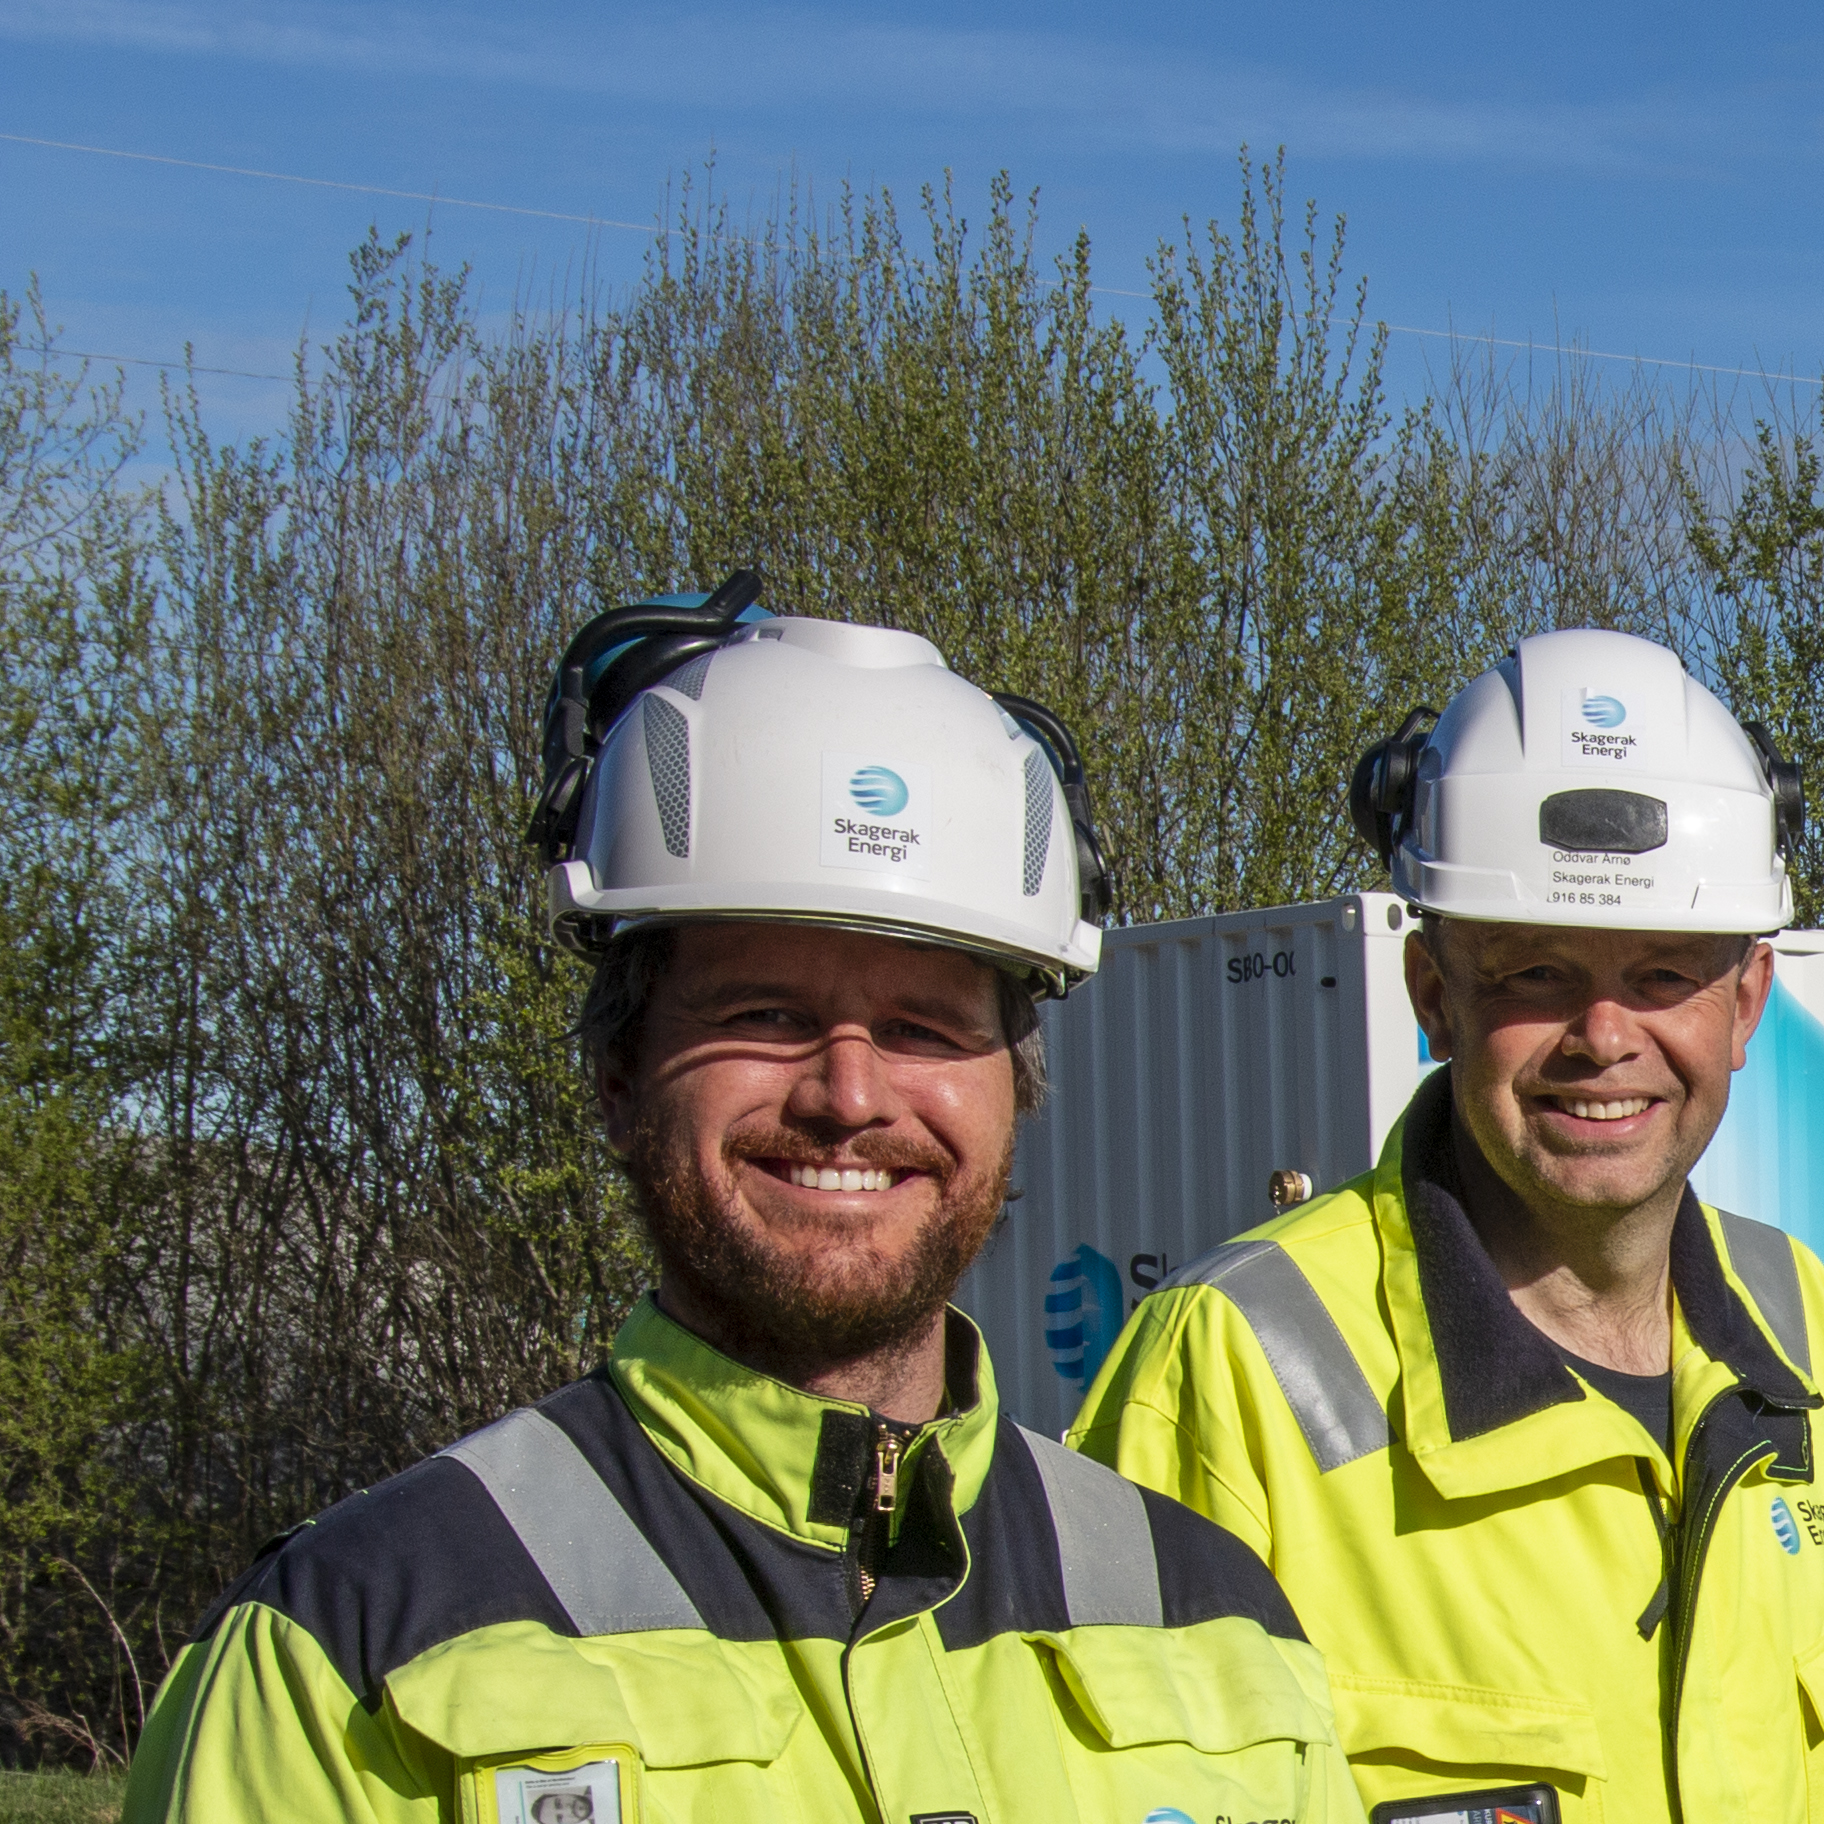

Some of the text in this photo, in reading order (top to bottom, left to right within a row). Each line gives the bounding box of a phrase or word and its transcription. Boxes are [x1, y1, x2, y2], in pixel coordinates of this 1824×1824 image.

[1571, 731, 1637, 746] Skagerak
[1582, 744, 1628, 759] Energi
[834, 818, 921, 846] Skagerak
[848, 835, 908, 862] Energi
[1552, 850, 1599, 864] Oddvar
[1552, 871, 1655, 889] Skagerak Energi
[1552, 891, 1622, 906] 916 85 384
